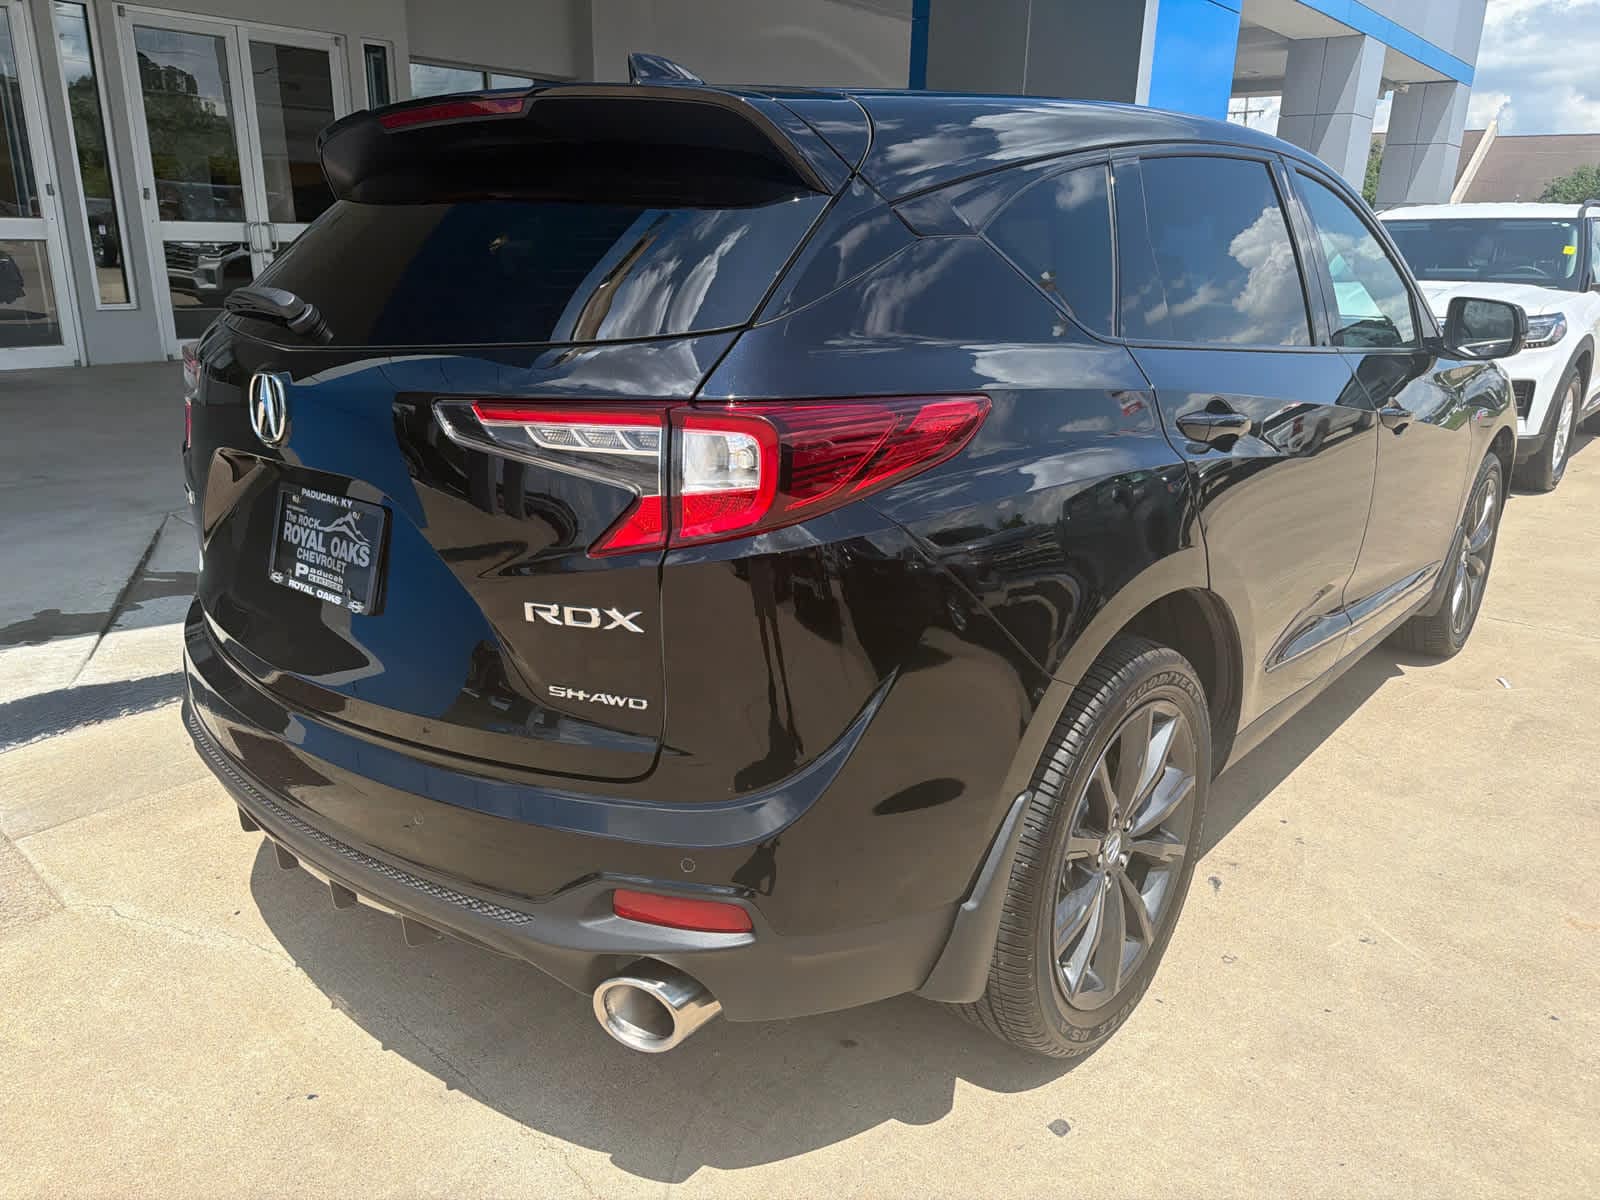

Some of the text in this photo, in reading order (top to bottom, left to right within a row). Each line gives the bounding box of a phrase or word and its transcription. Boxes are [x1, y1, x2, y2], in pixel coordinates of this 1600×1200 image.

[301, 487, 353, 509] PADUCAH, KY
[285, 510, 320, 530] The ROCK
[283, 522, 371, 567] ROYAL OAKS
[296, 547, 347, 574] CHEVROLET
[288, 579, 315, 596] ROYAL
[316, 589, 342, 605] OAKS
[523, 601, 645, 633] RDX
[548, 685, 648, 710] SH-AWD
